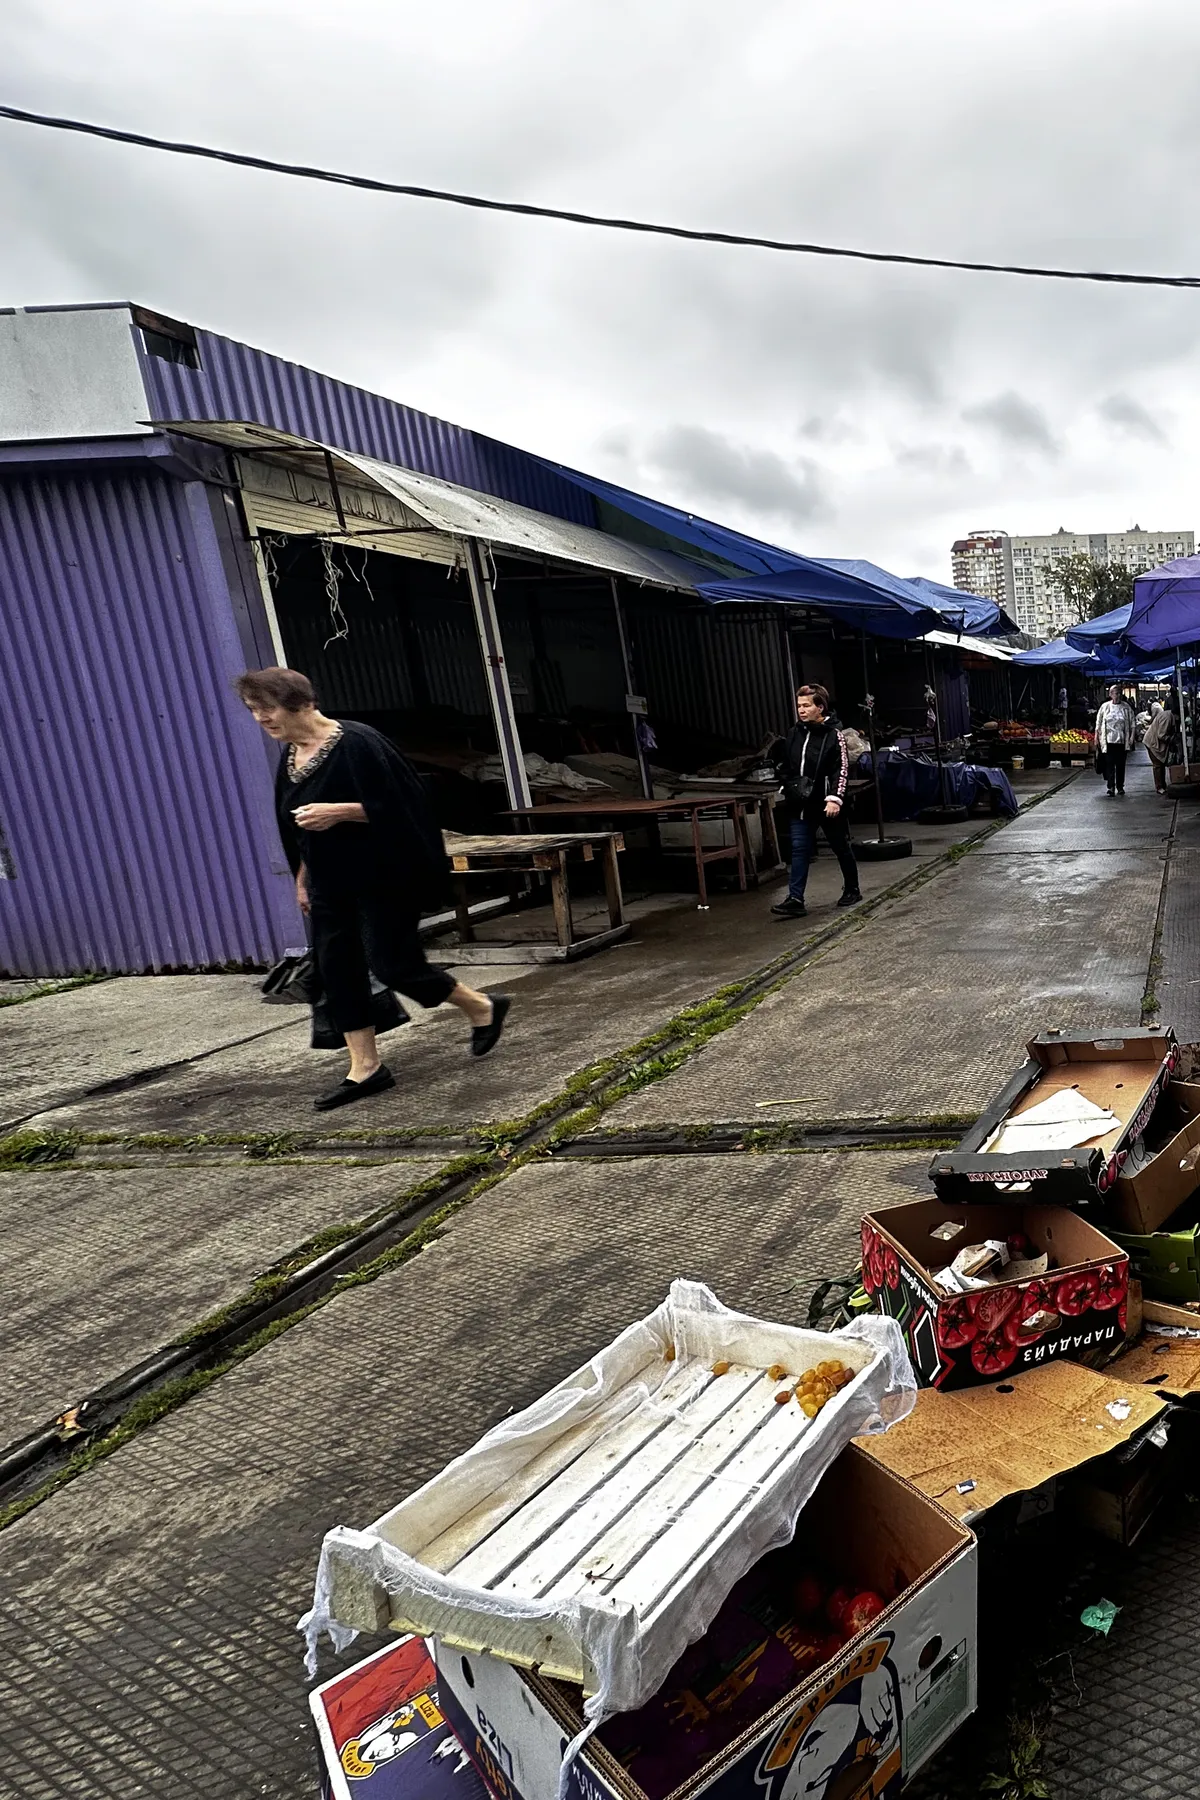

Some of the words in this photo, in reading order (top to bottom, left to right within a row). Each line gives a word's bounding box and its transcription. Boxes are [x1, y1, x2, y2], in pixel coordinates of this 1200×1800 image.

[966, 1169, 1048, 1182] КРАСНОДАР
[1023, 1326, 1115, 1361] ПАРАДАЙЗ
[419, 1699, 434, 1719] Liza
[782, 1648, 876, 1748] Ecuador
[476, 1704, 515, 1782] Liza
[345, 1746, 367, 1773] Ecuador
